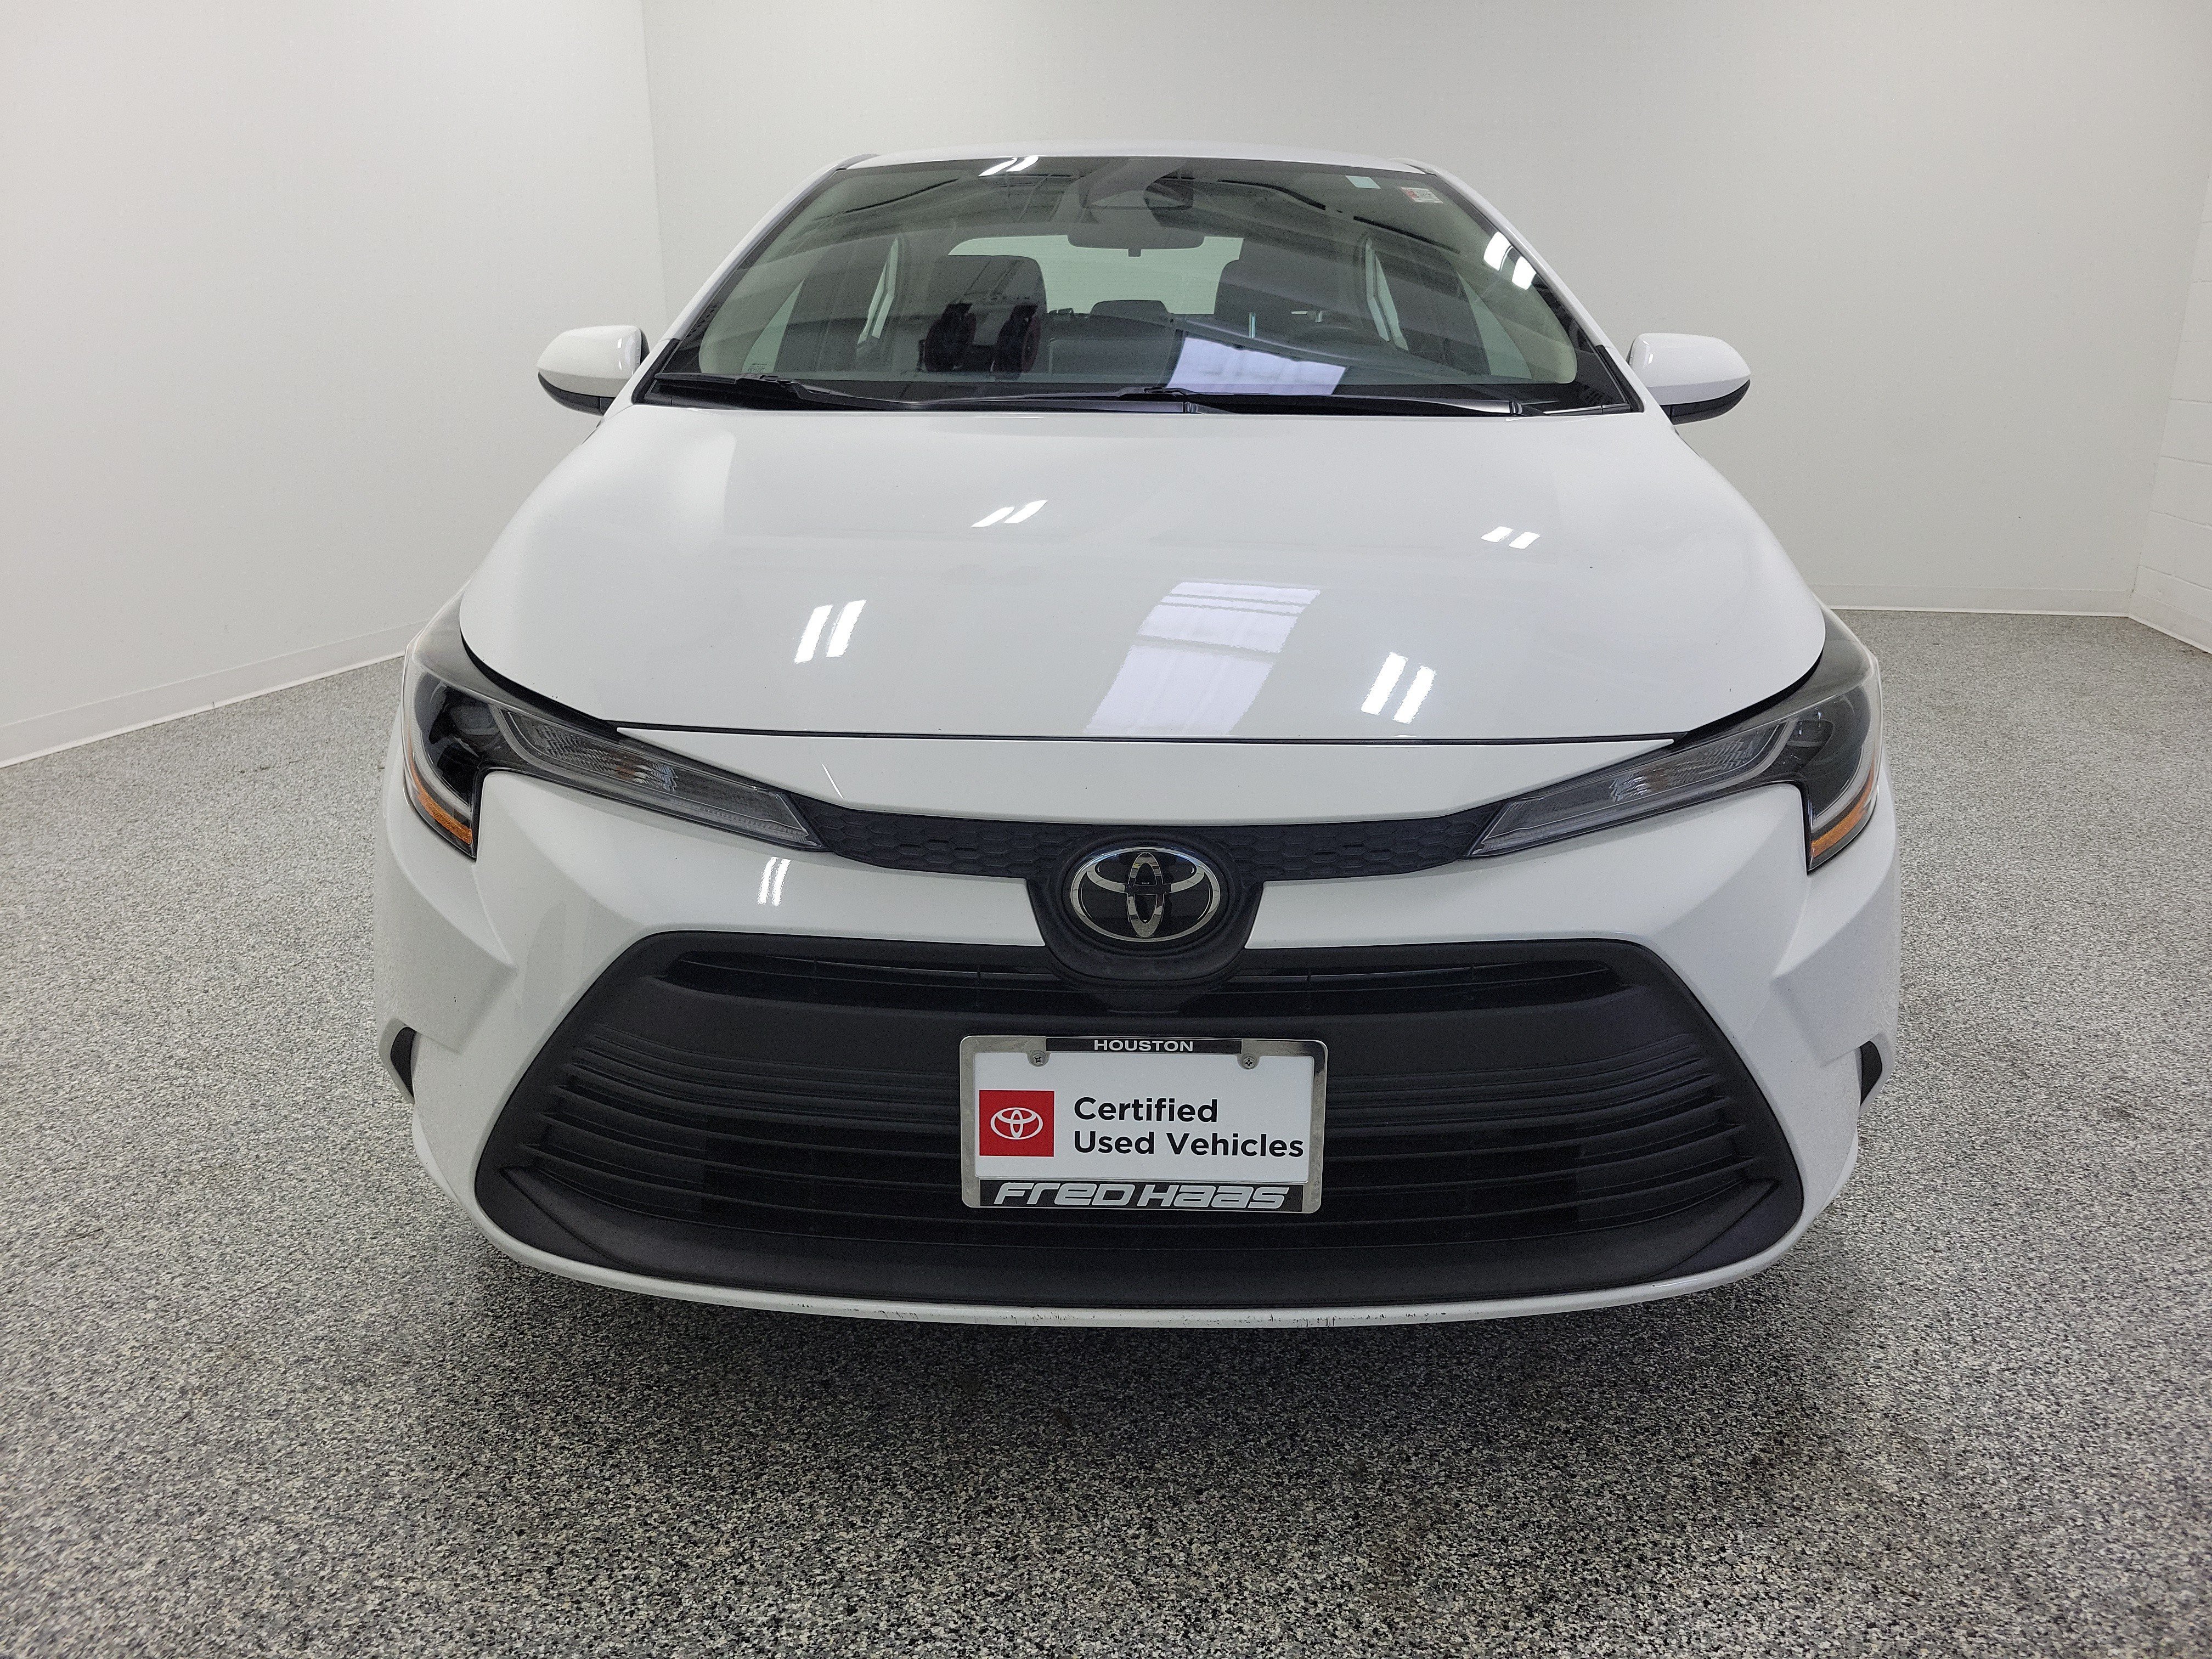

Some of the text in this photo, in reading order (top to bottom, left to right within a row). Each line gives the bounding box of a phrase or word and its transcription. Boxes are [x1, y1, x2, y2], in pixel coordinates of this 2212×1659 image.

[1093, 1040, 1194, 1052] HOUSTON
[1074, 1097, 1218, 1122] Certified
[1074, 1130, 1304, 1157] Used Vehicles
